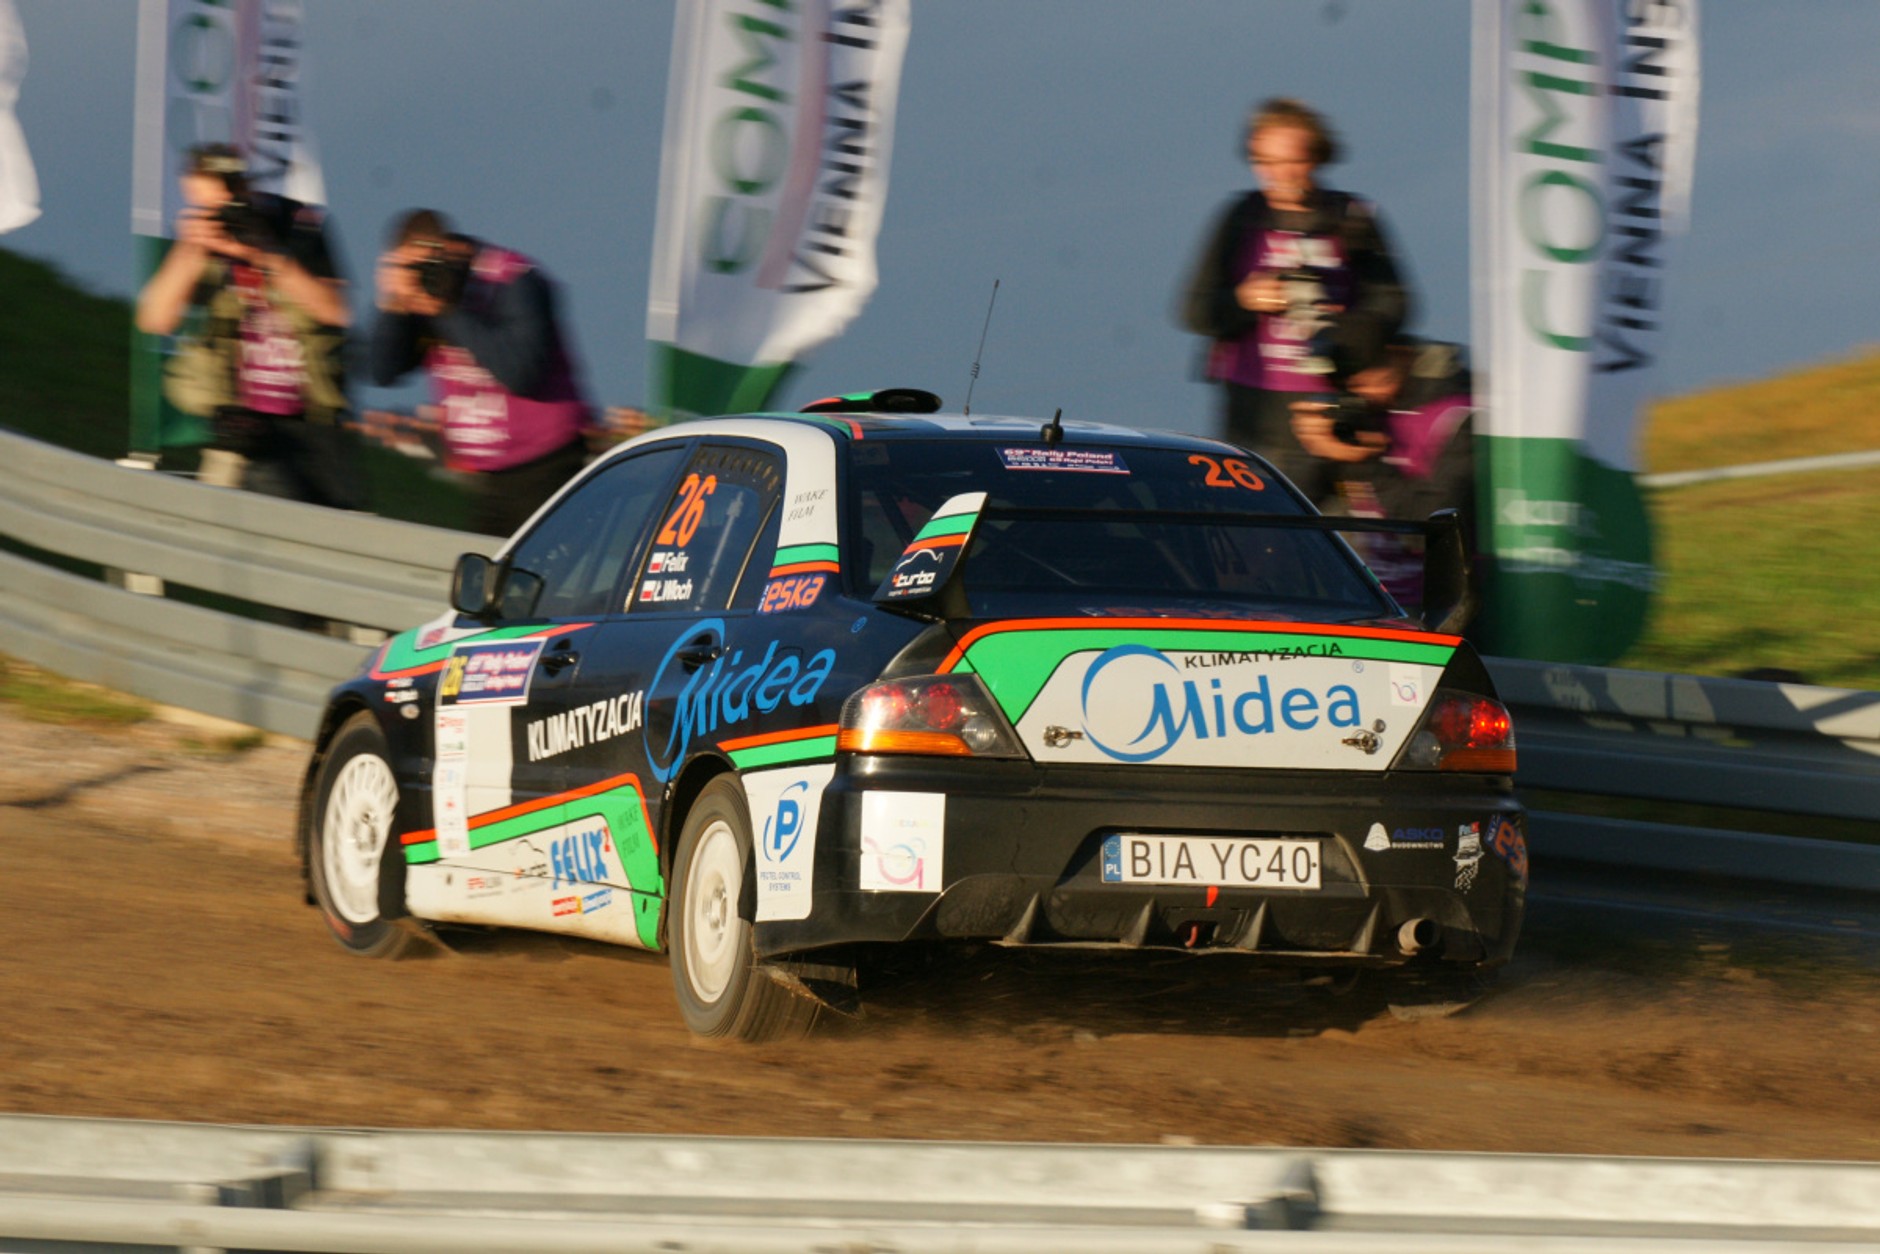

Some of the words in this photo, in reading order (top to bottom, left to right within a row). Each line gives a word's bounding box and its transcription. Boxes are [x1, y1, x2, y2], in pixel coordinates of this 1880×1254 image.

[703, 0, 800, 275] COM
[783, 80, 872, 294] VIENNA
[1590, 132, 1664, 374] VIENNA
[1031, 449, 1065, 459] Rally
[1066, 451, 1114, 460] Poland
[1188, 455, 1265, 491] 26
[656, 473, 717, 548] 26
[661, 551, 689, 573] Felix
[763, 576, 825, 613] eska
[1184, 642, 1342, 669] KLIMATYZACJA
[527, 689, 643, 762] KLIMATYZACJA
[643, 635, 836, 784] Midea
[1081, 672, 1361, 763] Midea
[1392, 827, 1444, 841] ASKO
[1106, 863, 1121, 875] PL
[1131, 840, 1197, 879] BIA
[1211, 842, 1312, 884] YC40
